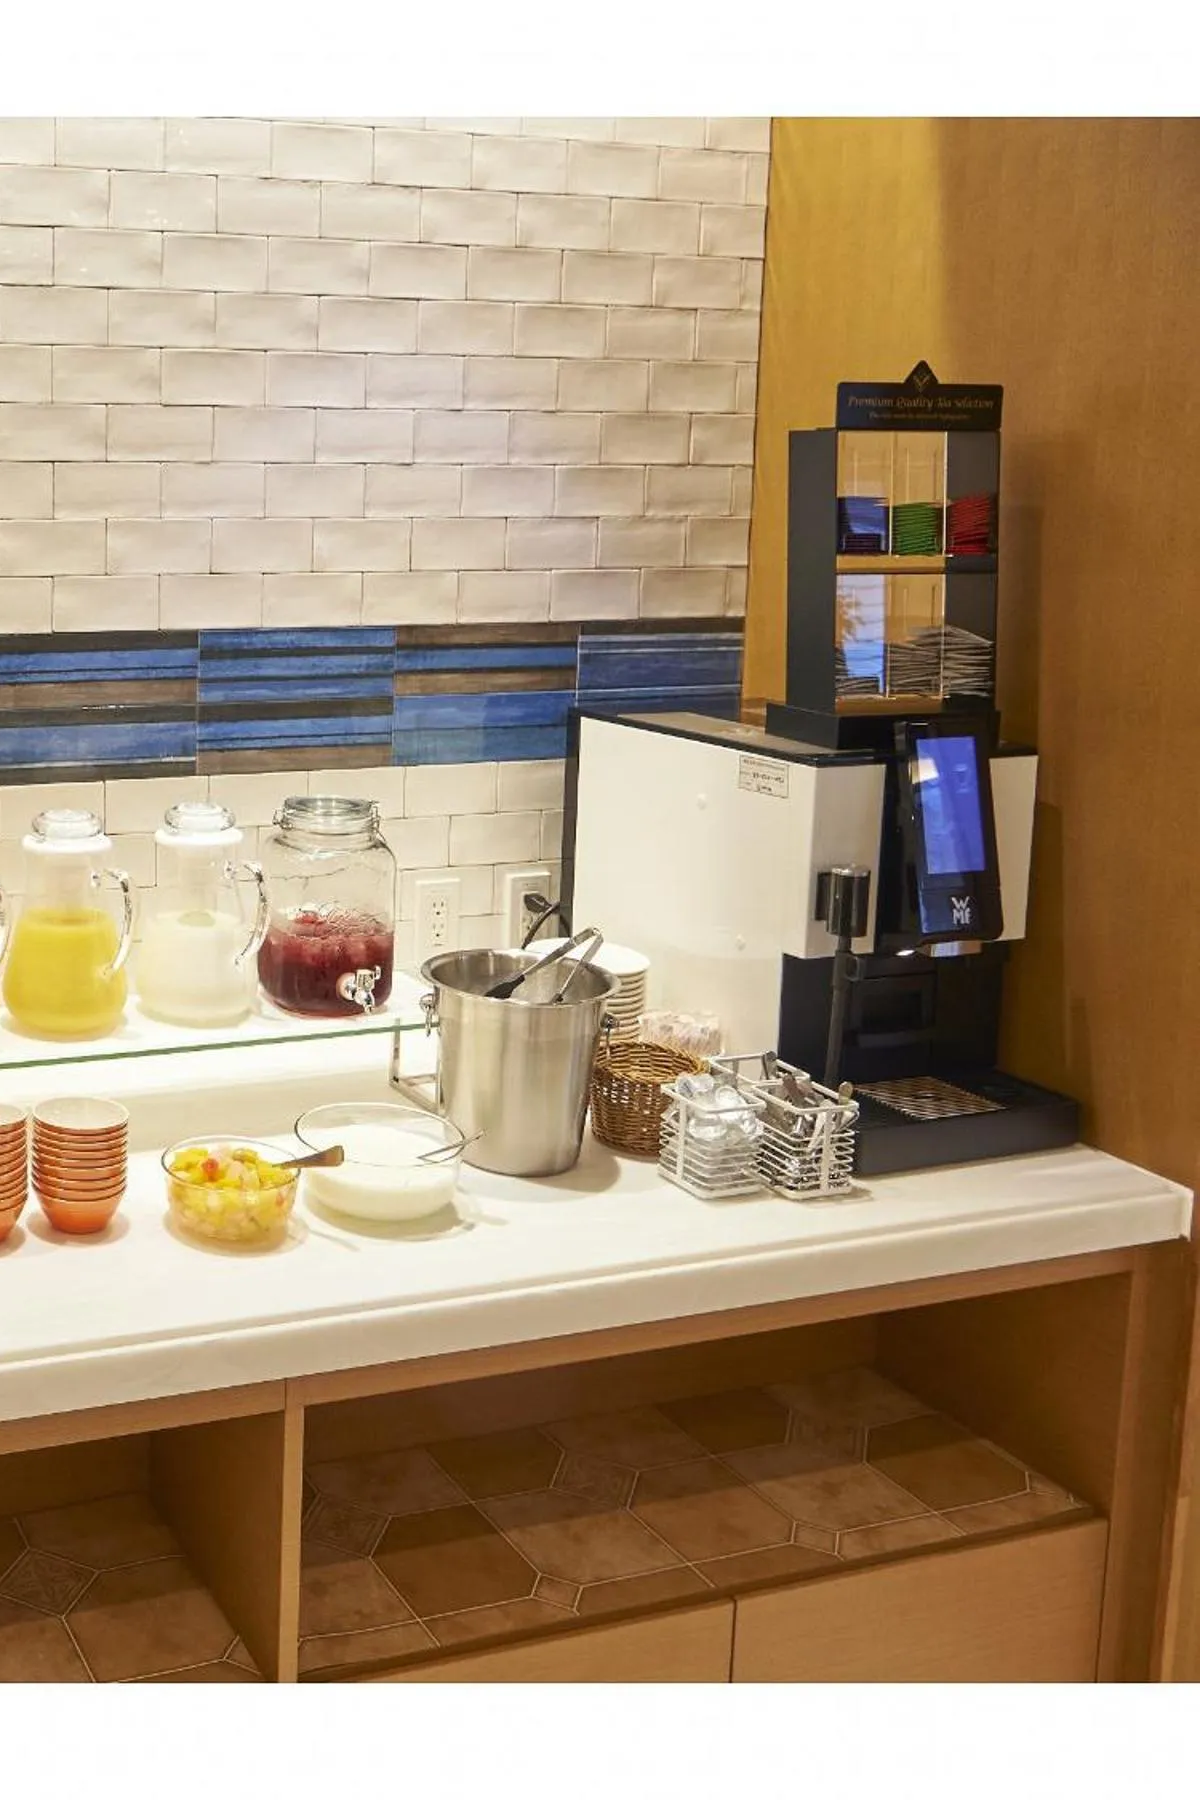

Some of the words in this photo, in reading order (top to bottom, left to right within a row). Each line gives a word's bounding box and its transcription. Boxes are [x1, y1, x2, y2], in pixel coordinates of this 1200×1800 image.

[848, 396, 893, 408] Premium
[895, 396, 933, 410] Quality
[951, 896, 971, 925] WMF
